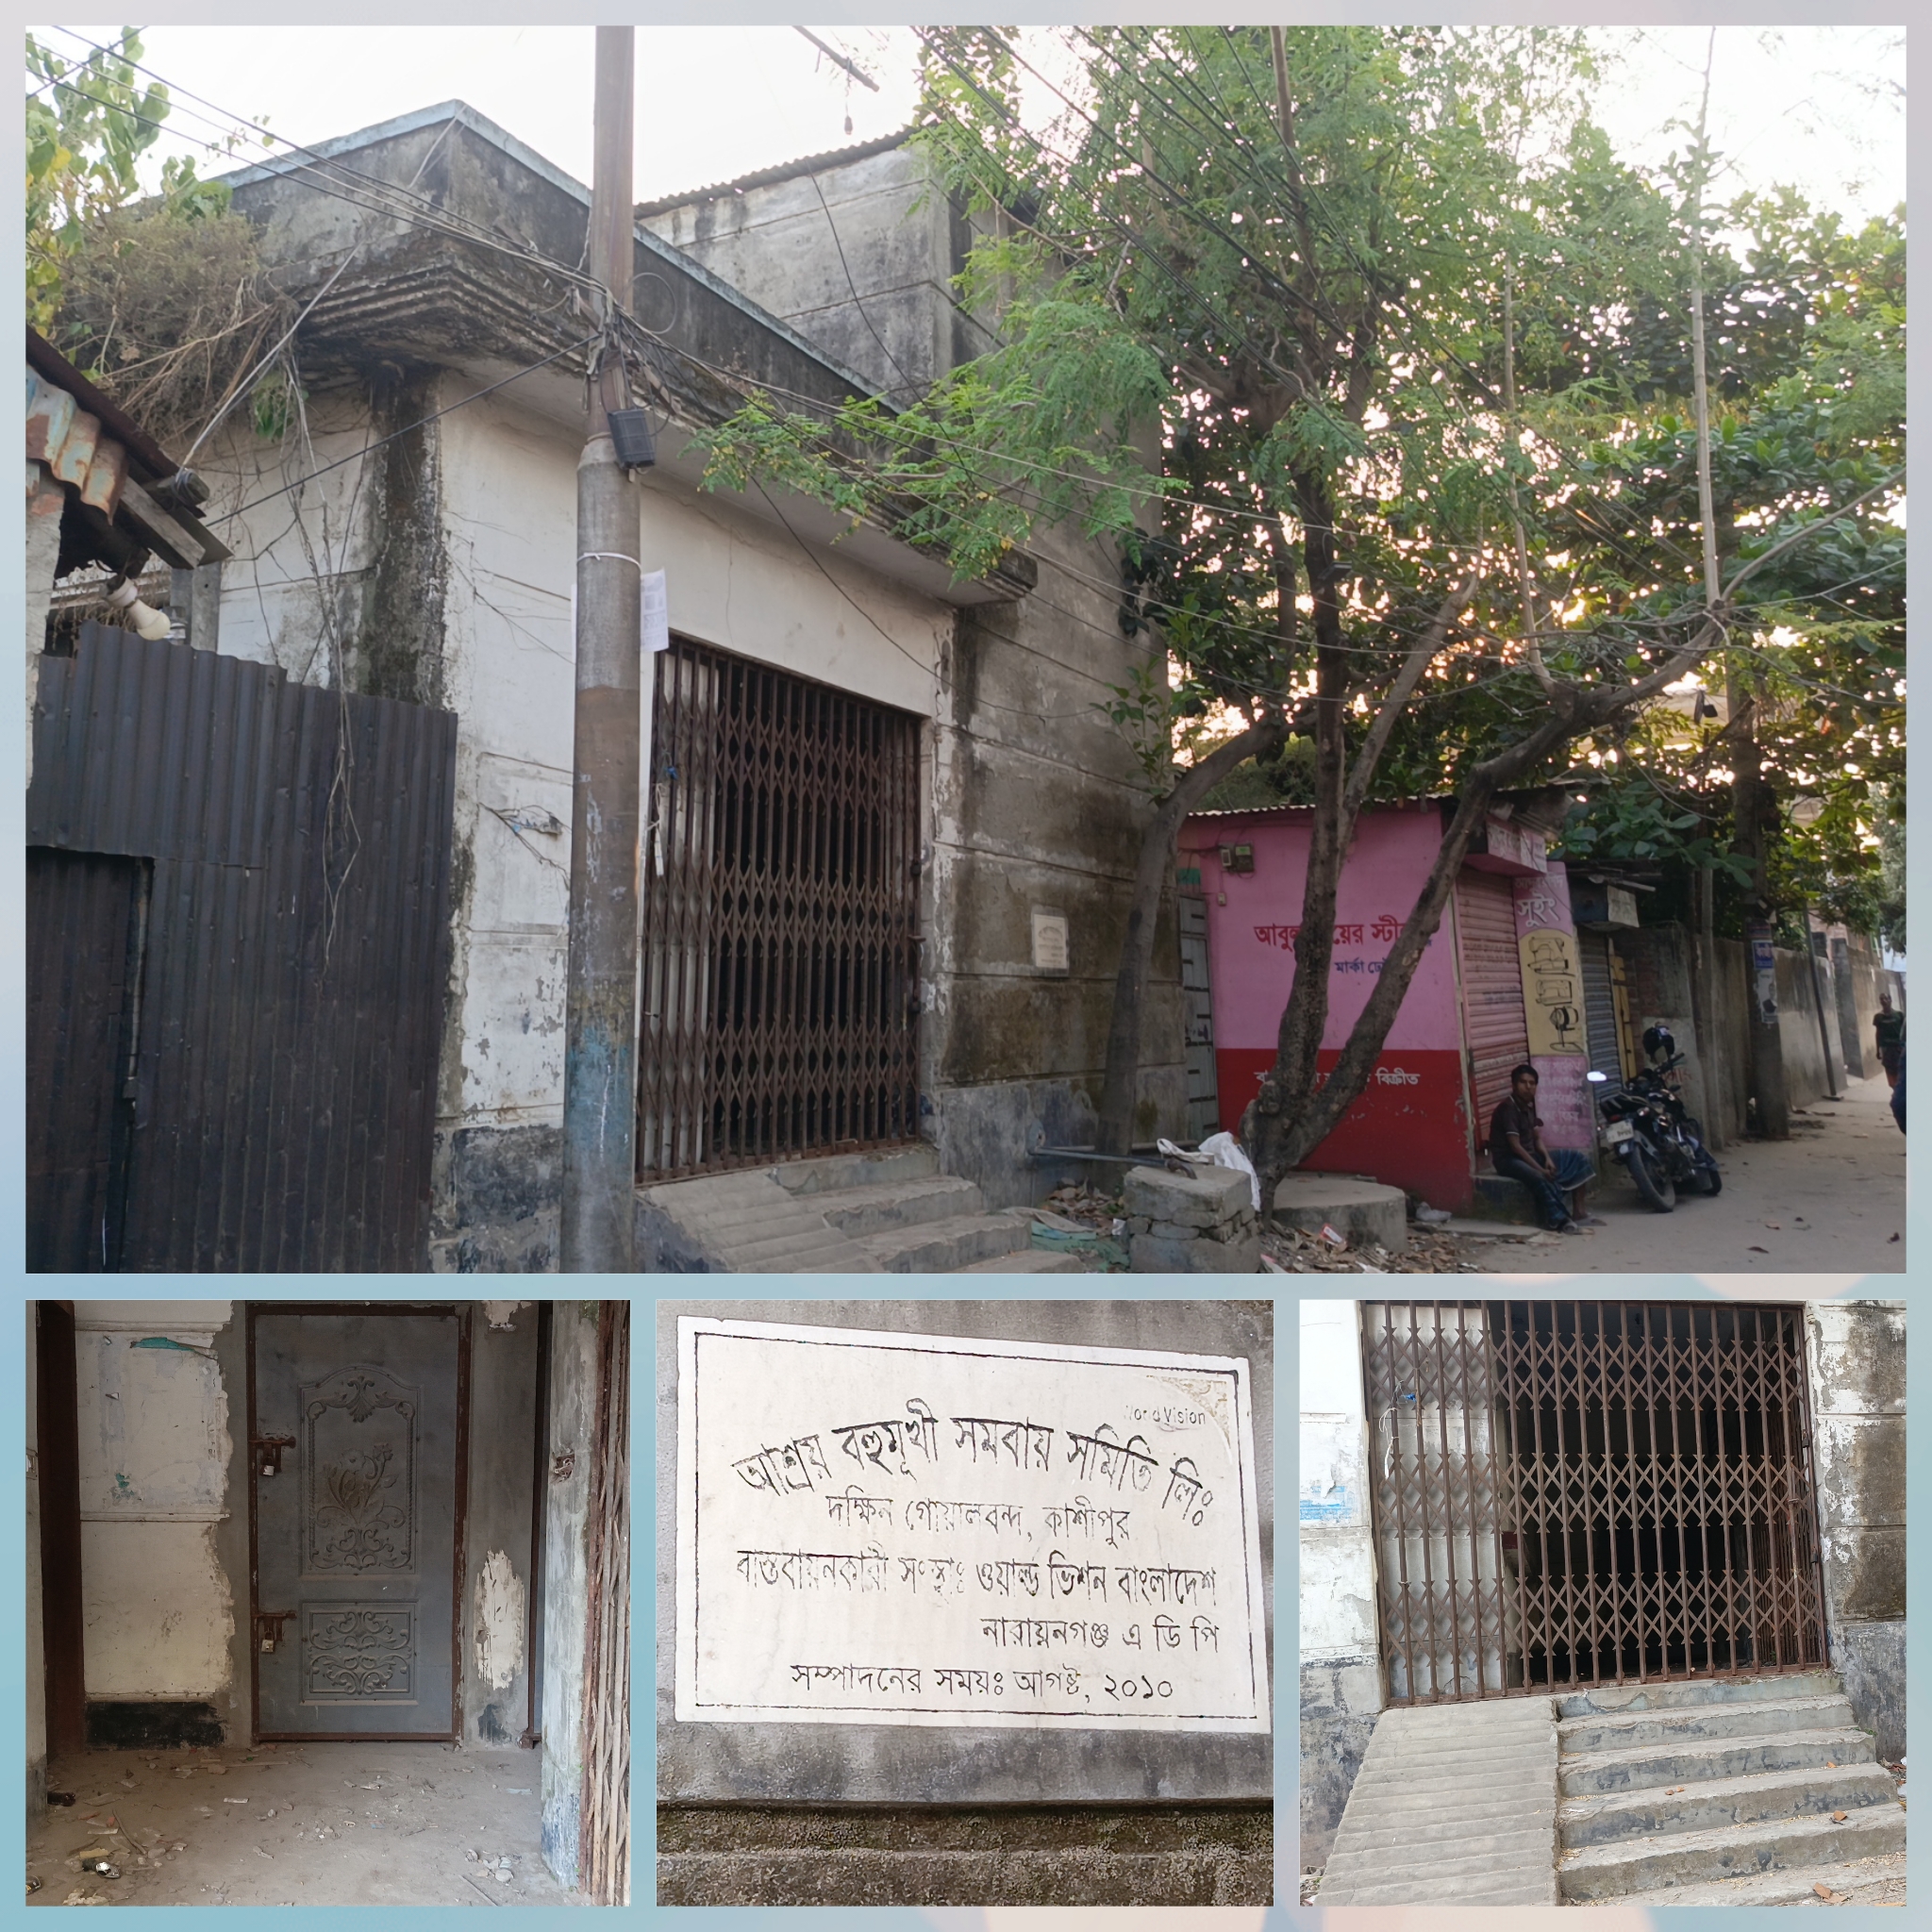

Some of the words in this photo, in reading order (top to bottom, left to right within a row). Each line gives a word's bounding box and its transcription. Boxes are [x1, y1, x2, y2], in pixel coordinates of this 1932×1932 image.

[1516, 890, 1561, 928] সুইং
[1370, 914, 1407, 944] স্টী
[1334, 957, 1365, 974] মার্কা
[1374, 1066, 1421, 1086] বিক্রীত
[1163, 1406, 1206, 1425] Vision
[730, 1434, 832, 1497] আশ্রয়
[949, 1416, 1055, 1473] সমবায়
[1065, 1423, 1159, 1492] সমিতি
[1041, 1494, 1131, 1550] কাশীপুর
[1046, 1549, 1108, 1604] ভিশন
[1114, 1562, 1218, 1607] বাংলাদেশ
[1122, 1624, 1141, 1650] এ
[1152, 1613, 1182, 1653] ডি
[1189, 1614, 1220, 1654] পি
[790, 1662, 923, 1694] সম্পাদনের
[1104, 1674, 1174, 1702] ২০১০
